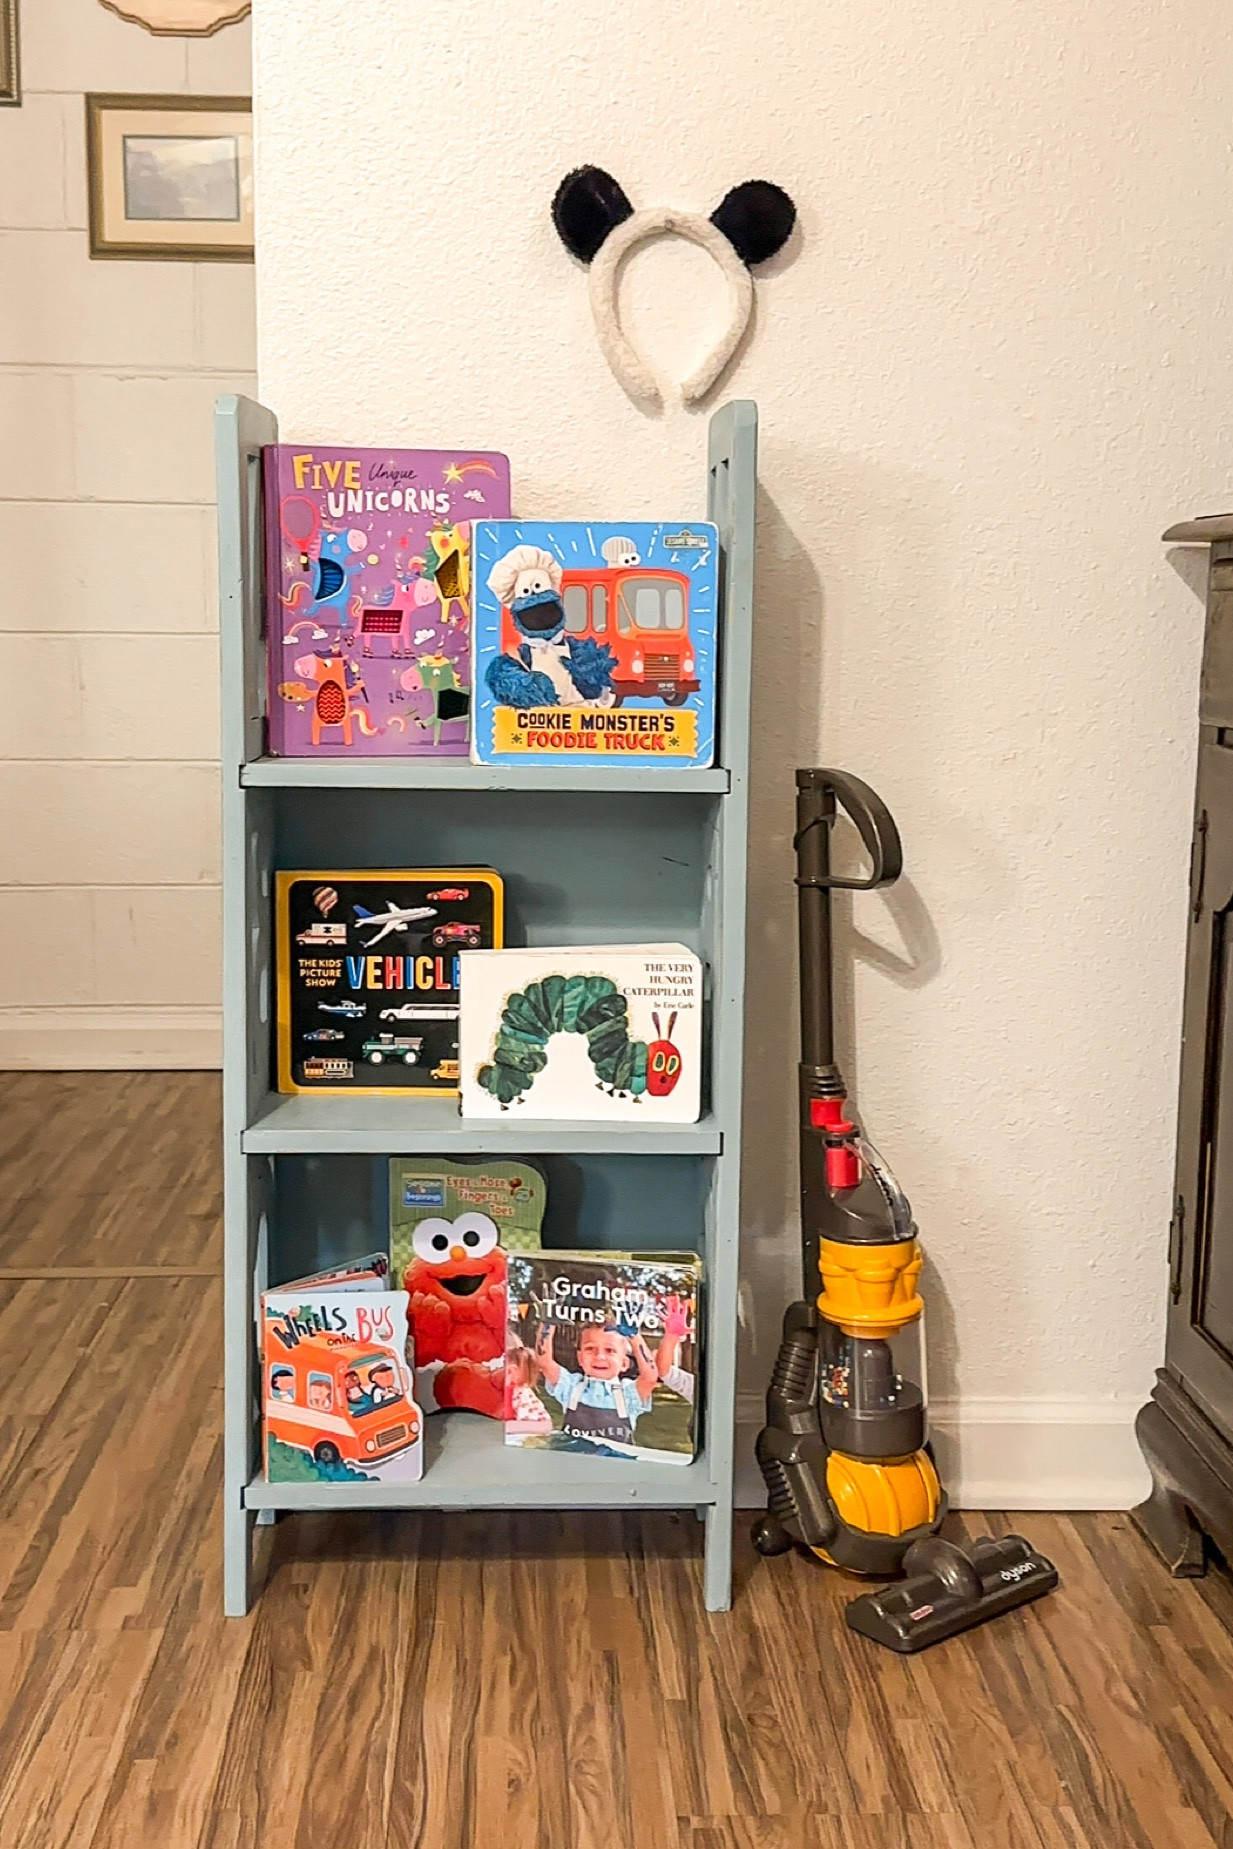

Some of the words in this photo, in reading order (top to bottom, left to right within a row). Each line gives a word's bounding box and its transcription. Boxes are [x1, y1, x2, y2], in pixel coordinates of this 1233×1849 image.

[292, 453, 361, 490] FIVE
[368, 462, 418, 487] Unique
[326, 487, 451, 518] UNICORNS
[517, 712, 572, 729] COOKIE
[580, 713, 675, 732] MONSTER'S
[526, 731, 598, 749] FOODIE
[603, 733, 666, 751] TRUCK
[298, 959, 317, 968] THE
[644, 963, 666, 972] THE
[667, 963, 694, 973] VERY
[300, 968, 342, 978] PICTURE
[649, 975, 694, 985] HUNGRY
[305, 978, 336, 987] SHOW
[622, 987, 695, 997] CATERPILLAR
[446, 1176, 471, 1187] Eyes
[459, 1189, 498, 1203] Fingers
[489, 1203, 513, 1216] Toes
[553, 1277, 649, 1305] Graham
[542, 1299, 606, 1324] Turns
[612, 1304, 660, 1329] Two
[355, 1305, 395, 1343] BUS
[999, 1562, 1037, 1582] dyson
